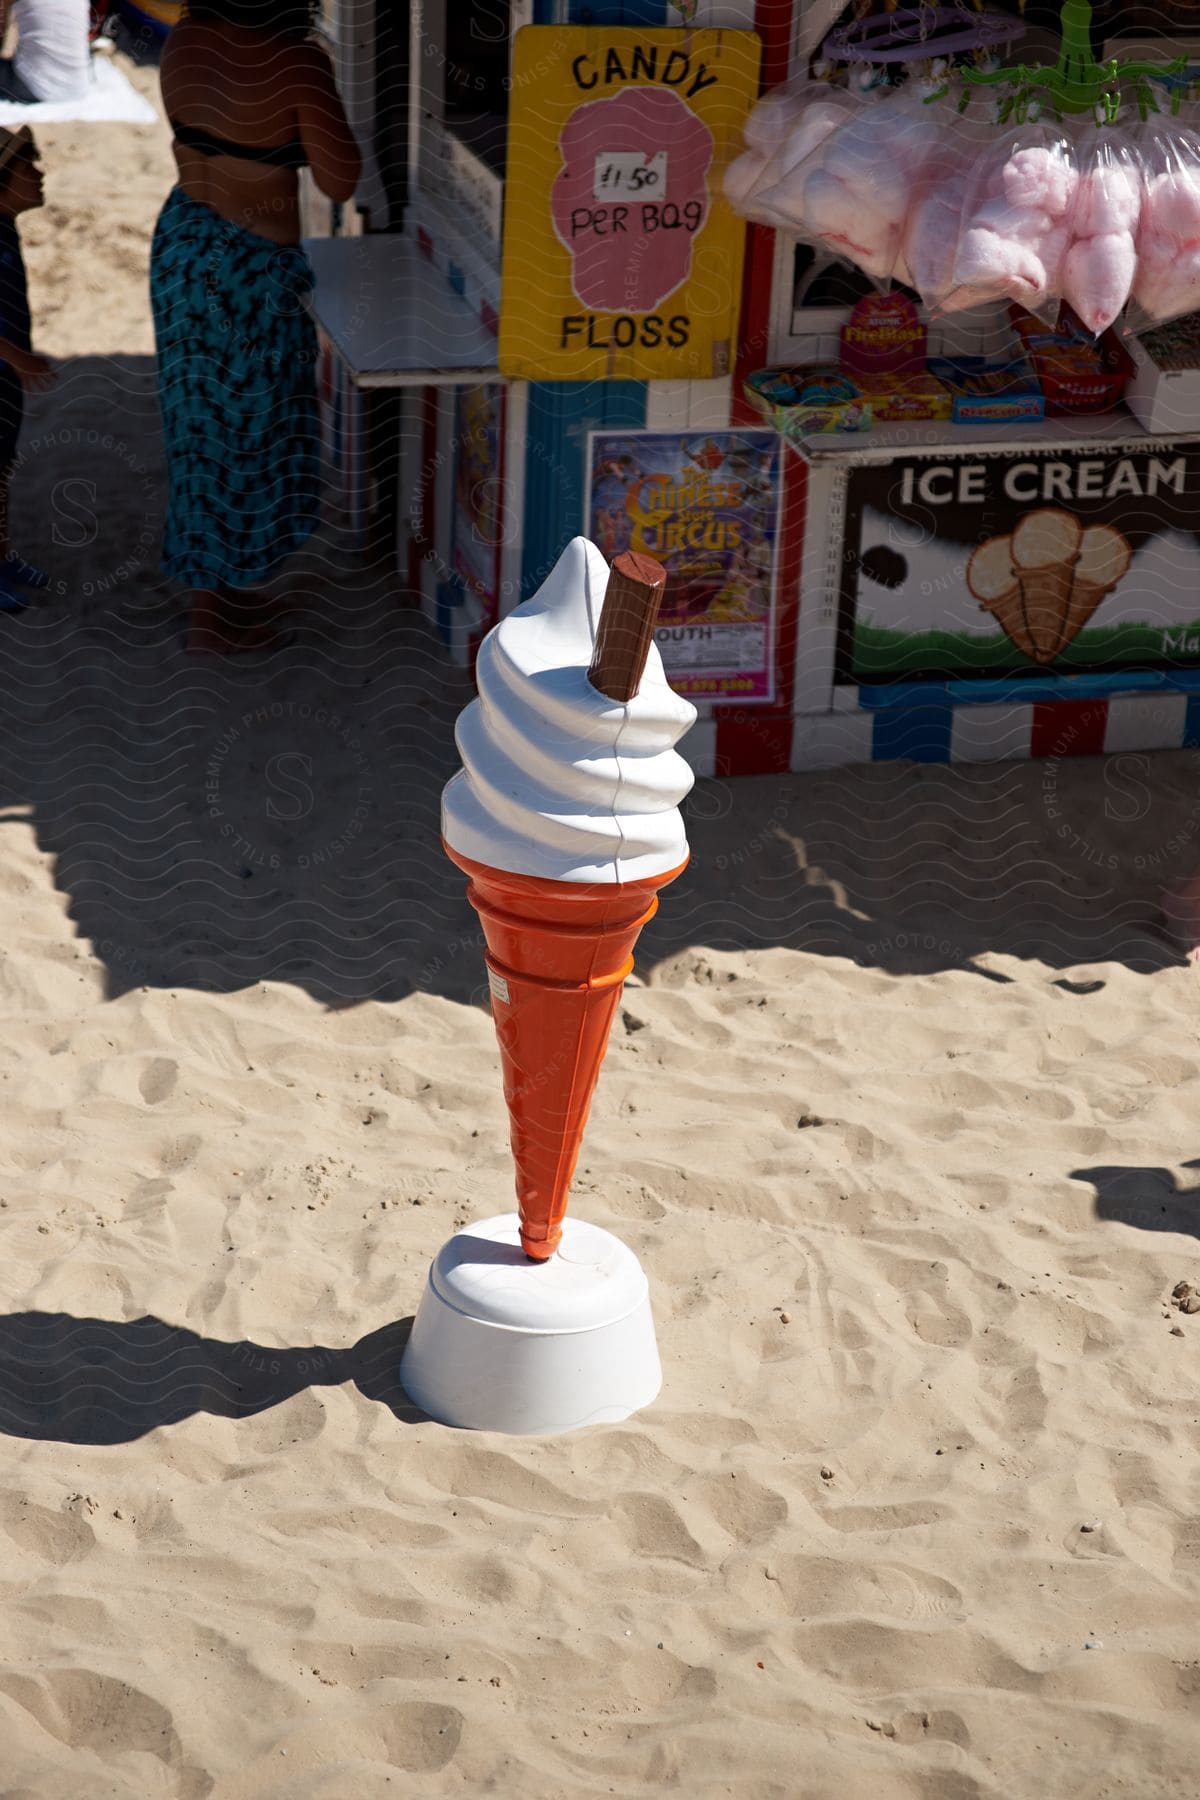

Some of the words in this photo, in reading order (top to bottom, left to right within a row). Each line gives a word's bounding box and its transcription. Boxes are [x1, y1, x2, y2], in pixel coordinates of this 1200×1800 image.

[572, 46, 718, 98] CANDY
[561, 315, 691, 348] FLOSS
[902, 464, 986, 505] ICE
[1002, 456, 1188, 501] CREAM
[629, 519, 742, 562] CIRCUS
